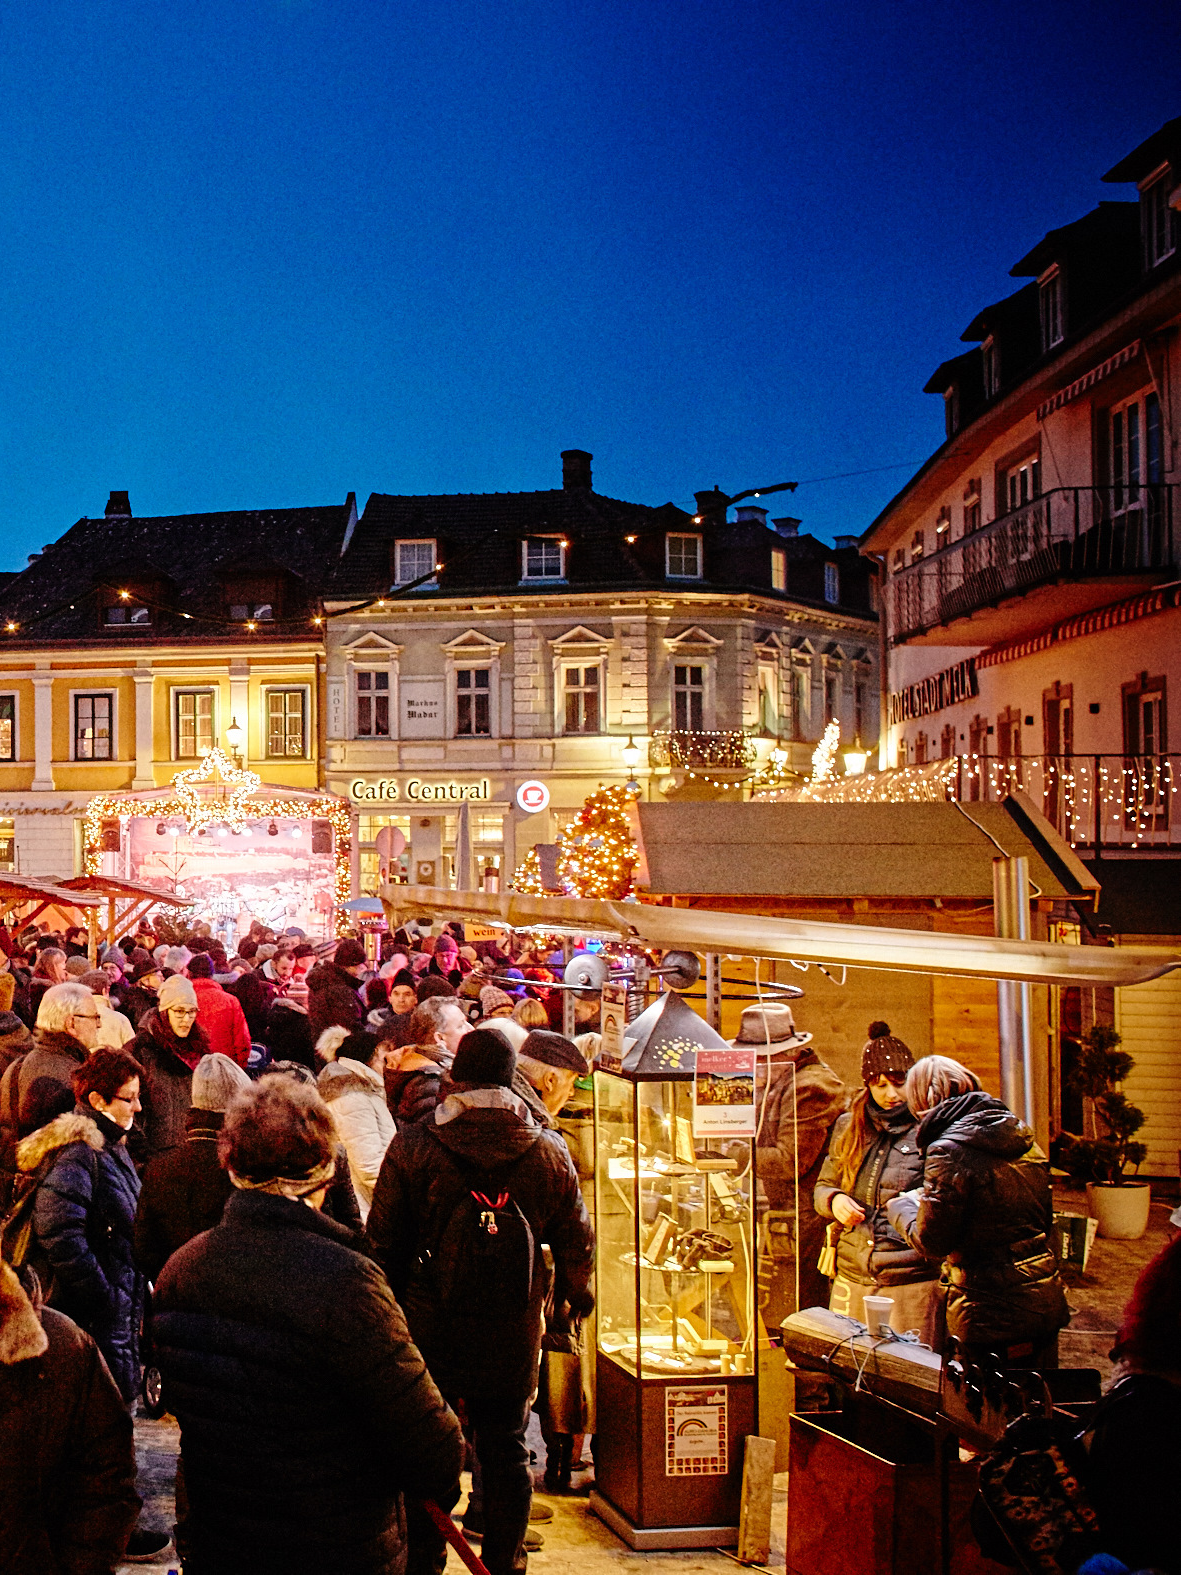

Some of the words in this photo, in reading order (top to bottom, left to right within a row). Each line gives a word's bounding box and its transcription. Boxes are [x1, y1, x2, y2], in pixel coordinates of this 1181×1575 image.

[888, 686, 913, 730] HOTEL
[914, 672, 944, 717] STADT
[944, 658, 974, 704] MELK
[352, 781, 397, 799] Café
[407, 780, 488, 799] Central
[473, 928, 496, 937] wein
